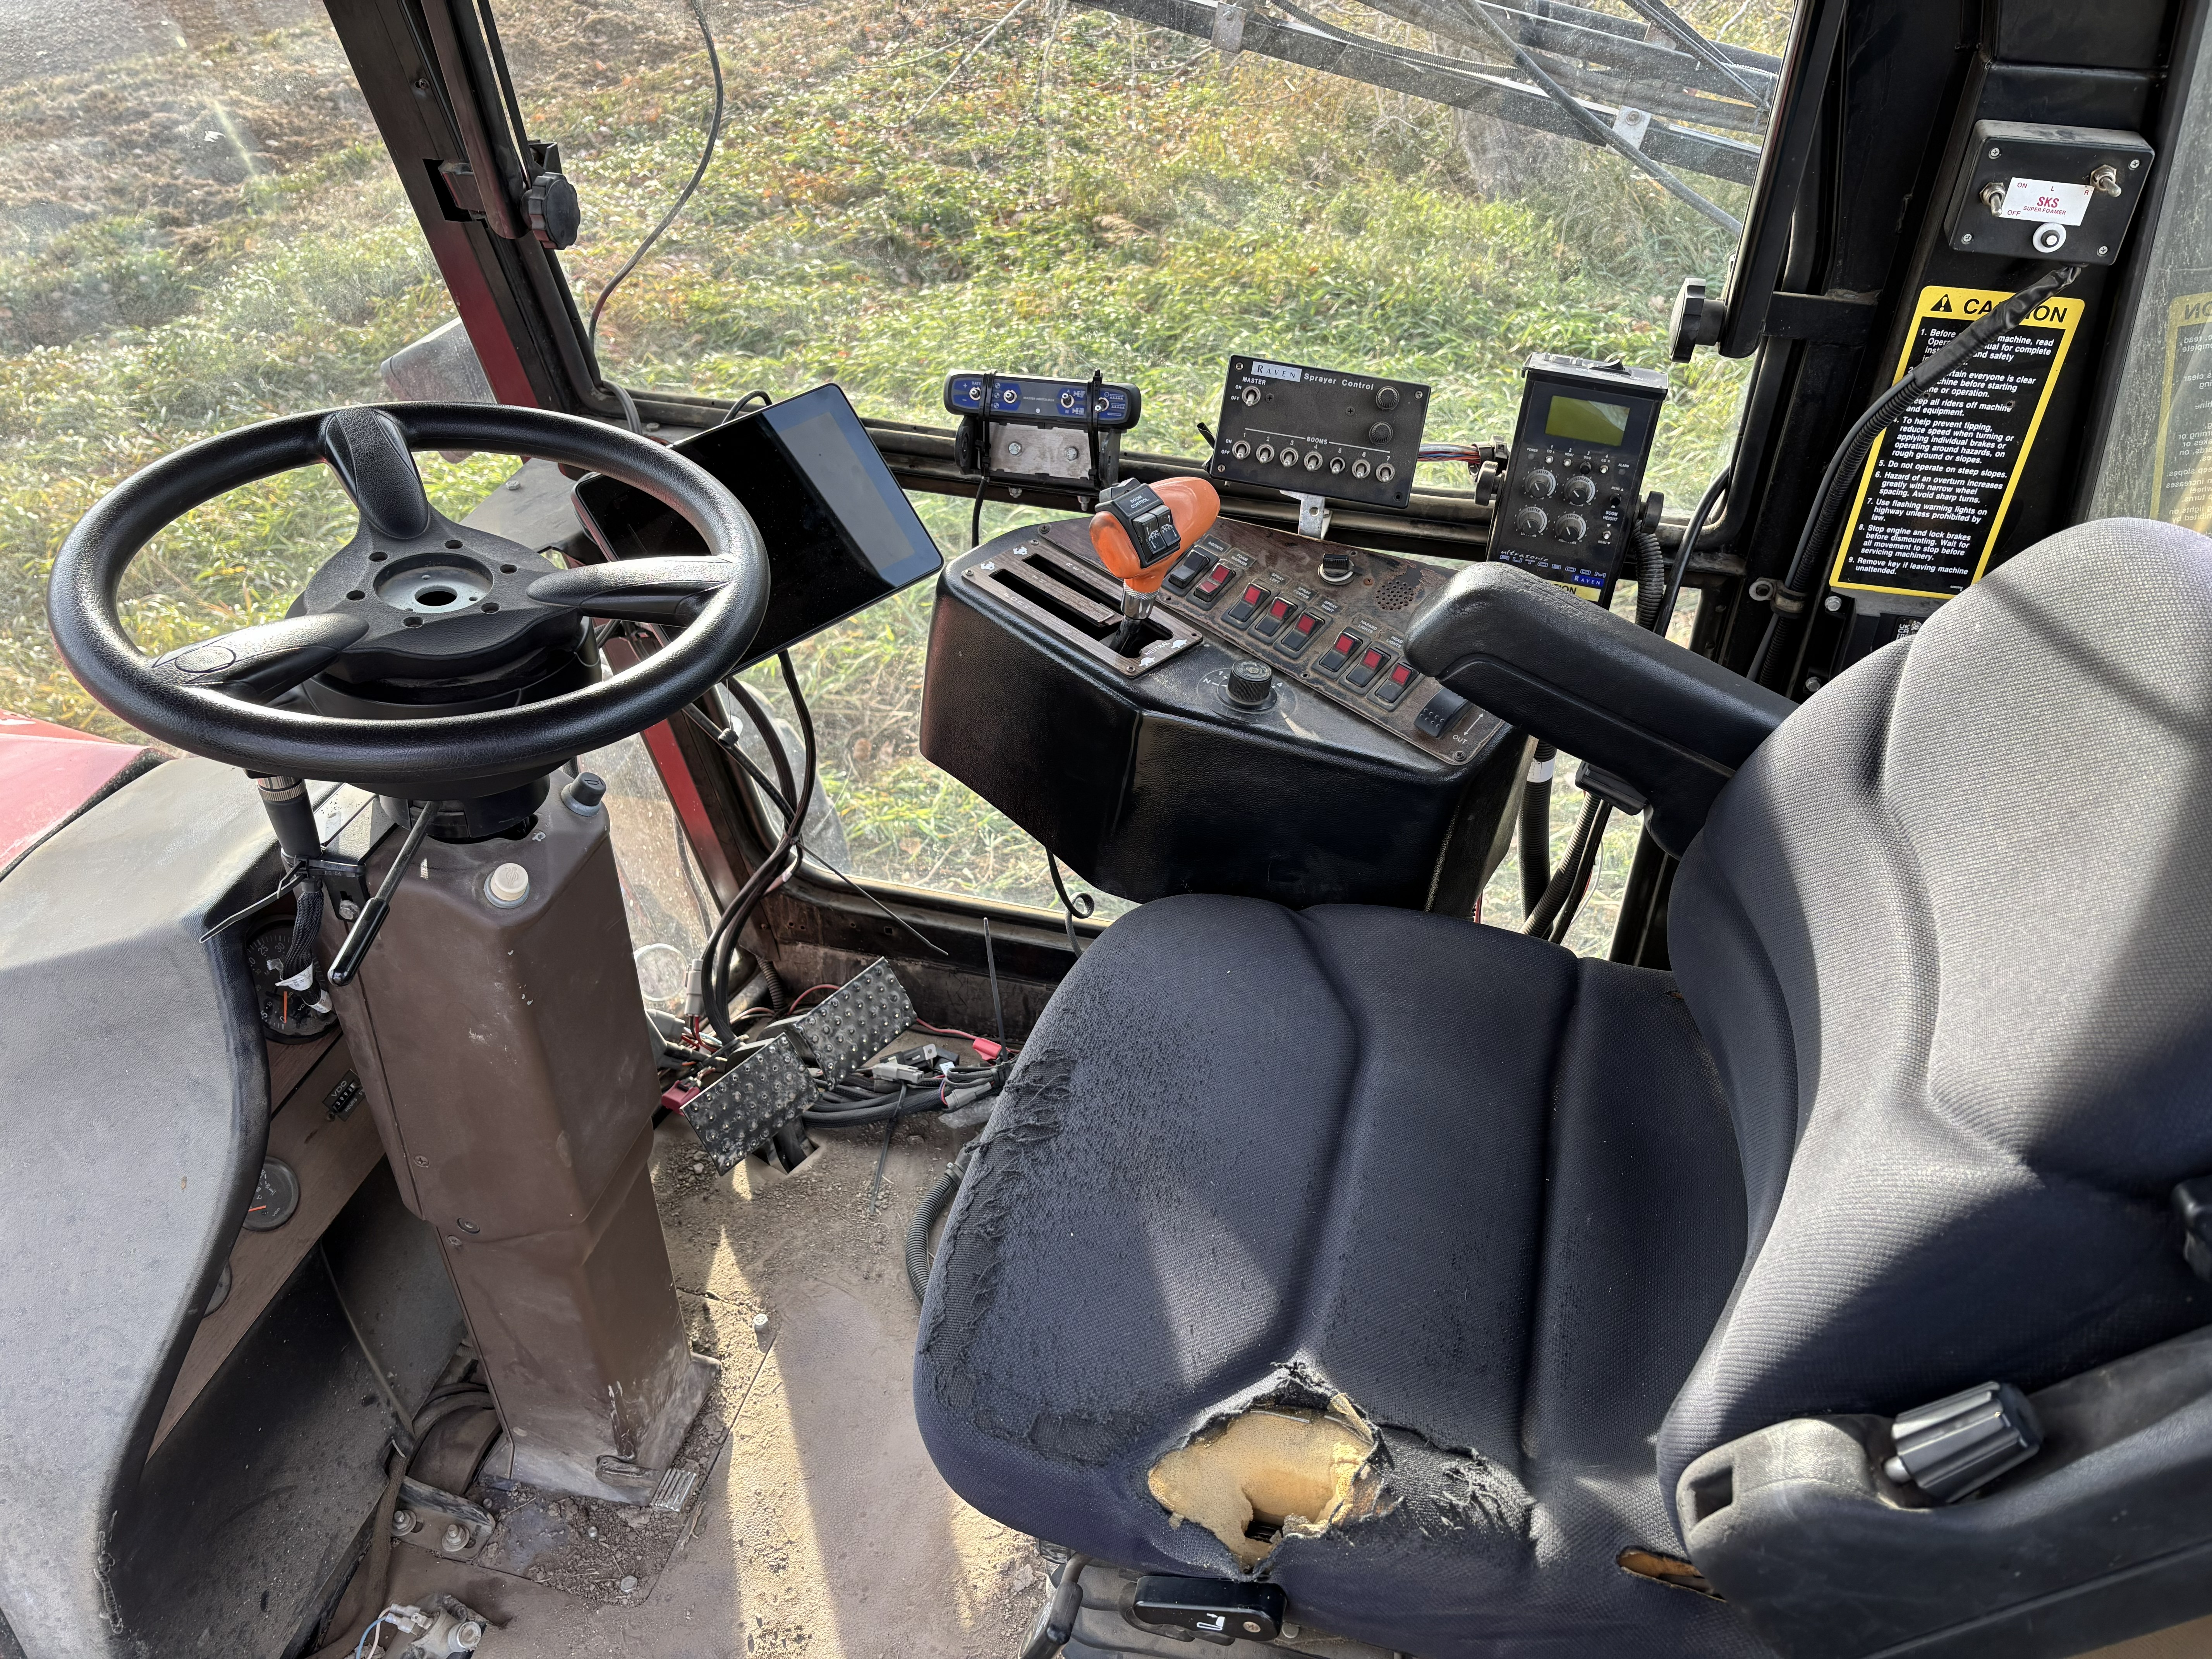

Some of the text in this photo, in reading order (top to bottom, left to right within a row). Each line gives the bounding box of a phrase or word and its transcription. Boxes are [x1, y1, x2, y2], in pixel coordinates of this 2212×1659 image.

[2037, 196, 2059, 208] SKS
[1930, 329, 1956, 337] Before
[1997, 336, 2032, 345] machine,
[1242, 376, 1266, 386] MASTER
[1257, 364, 1374, 391] RAVEN Sprayer Control
[1969, 373, 2004, 381] everyone
[2016, 376, 2036, 384] clear
[1960, 380, 2018, 393] before starting
[1951, 389, 1989, 397] operation.
[1941, 399, 1963, 407] riders
[1923, 407, 1964, 416] equipment.
[1914, 417, 1931, 427] help
[1932, 421, 1962, 429] prevent
[1964, 422, 1992, 432] tipping,
[1306, 436, 1328, 445] BOOMS
[1927, 428, 1951, 437] speed
[1976, 432, 2003, 442] turning
[1897, 434, 1929, 443] applying
[1931, 436, 1968, 446] individual
[1970, 439, 1995, 448] brakes
[1895, 442, 1930, 452] operating
[1932, 446, 1959, 454] around
[1961, 447, 1992, 457] hazards,
[1955, 456, 1982, 464] slopes.
[1958, 467, 1979, 476] steep
[1981, 469, 2007, 478] slopes.
[1881, 481, 1907, 490] greatly
[1884, 472, 1910, 480] Hazard
[1967, 479, 2003, 489] increases
[1130, 495, 1143, 503] BOOM
[1879, 489, 1909, 497] spacing.
[1936, 493, 1957, 502] sharp
[1130, 498, 1150, 509] CONTROL
[1892, 500, 1921, 510] flashing
[1923, 504, 1953, 513] warning
[1954, 506, 1975, 514] lights
[1874, 506, 1904, 516] highway
[1931, 513, 1970, 521] prohibited
[1868, 524, 1884, 533] Stop
[1946, 532, 1971, 541] brakes
[1866, 532, 1888, 541] before
[1891, 534, 1937, 546] dismounting.
[1941, 539, 1956, 547] Wait
[1207, 541, 1224, 551] AGITATE
[1237, 553, 1249, 562] FOAM
[1501, 550, 1549, 562] ultrasonic
[1861, 548, 1934, 561] servicing machinery.
[1231, 555, 1247, 566] MARKER
[1857, 557, 1886, 566] Remove
[1888, 560, 1901, 568] key
[1910, 563, 1936, 572] leaving
[1856, 566, 1896, 574] unattended.
[1271, 572, 1285, 582] SPRAY
[1574, 575, 1601, 586] RAVEN
[1293, 589, 1309, 600] CENTER
[1297, 586, 1311, 595] SPRAY
[1321, 605, 1334, 613] RIGHT
[1324, 600, 1338, 609] SPRAY
[1358, 624, 1374, 634] LIGHTS
[1360, 620, 1377, 630] HAZARD
[1386, 639, 1401, 648] LIGHTS
[1390, 635, 1403, 644] HEAD
[1144, 641, 1170, 656] NEUTRAL
[1453, 734, 1468, 744] OUT
[331, 1080, 347, 1097] VDO
